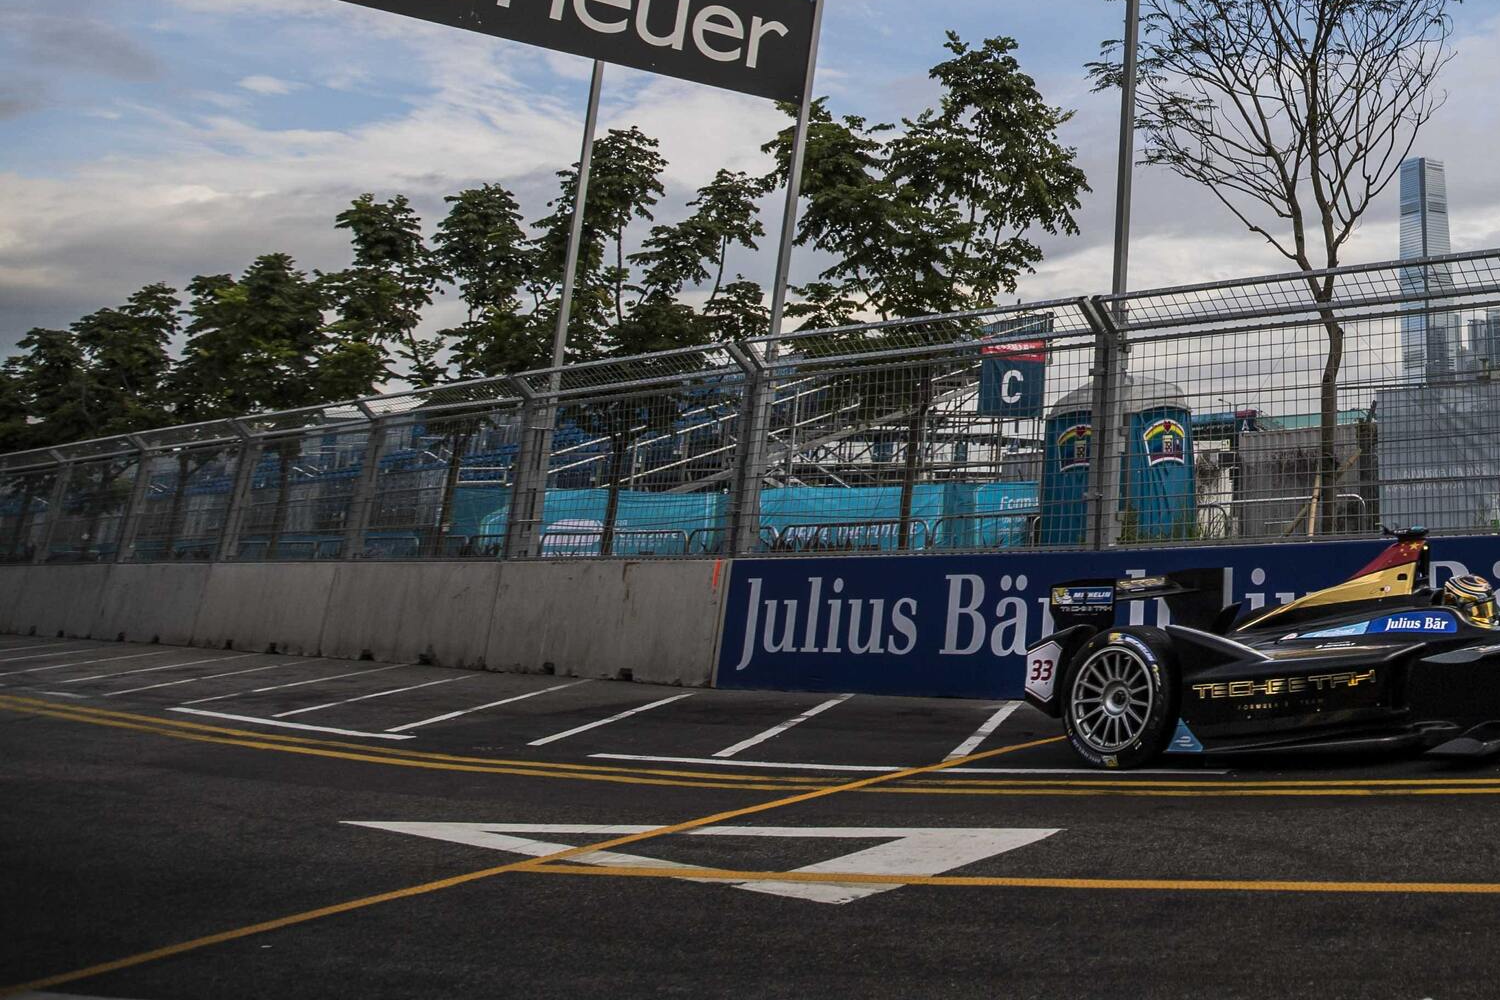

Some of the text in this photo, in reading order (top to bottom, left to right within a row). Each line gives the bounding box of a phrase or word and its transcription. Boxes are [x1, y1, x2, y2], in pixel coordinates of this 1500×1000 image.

[1001, 369, 1024, 404] C
[866, 521, 918, 539] FUTUE
[1072, 590, 1112, 599] MIHELIN
[736, 577, 918, 671] Julius
[1384, 617, 1449, 632] Julius Bär
[1030, 659, 1053, 681] 33
